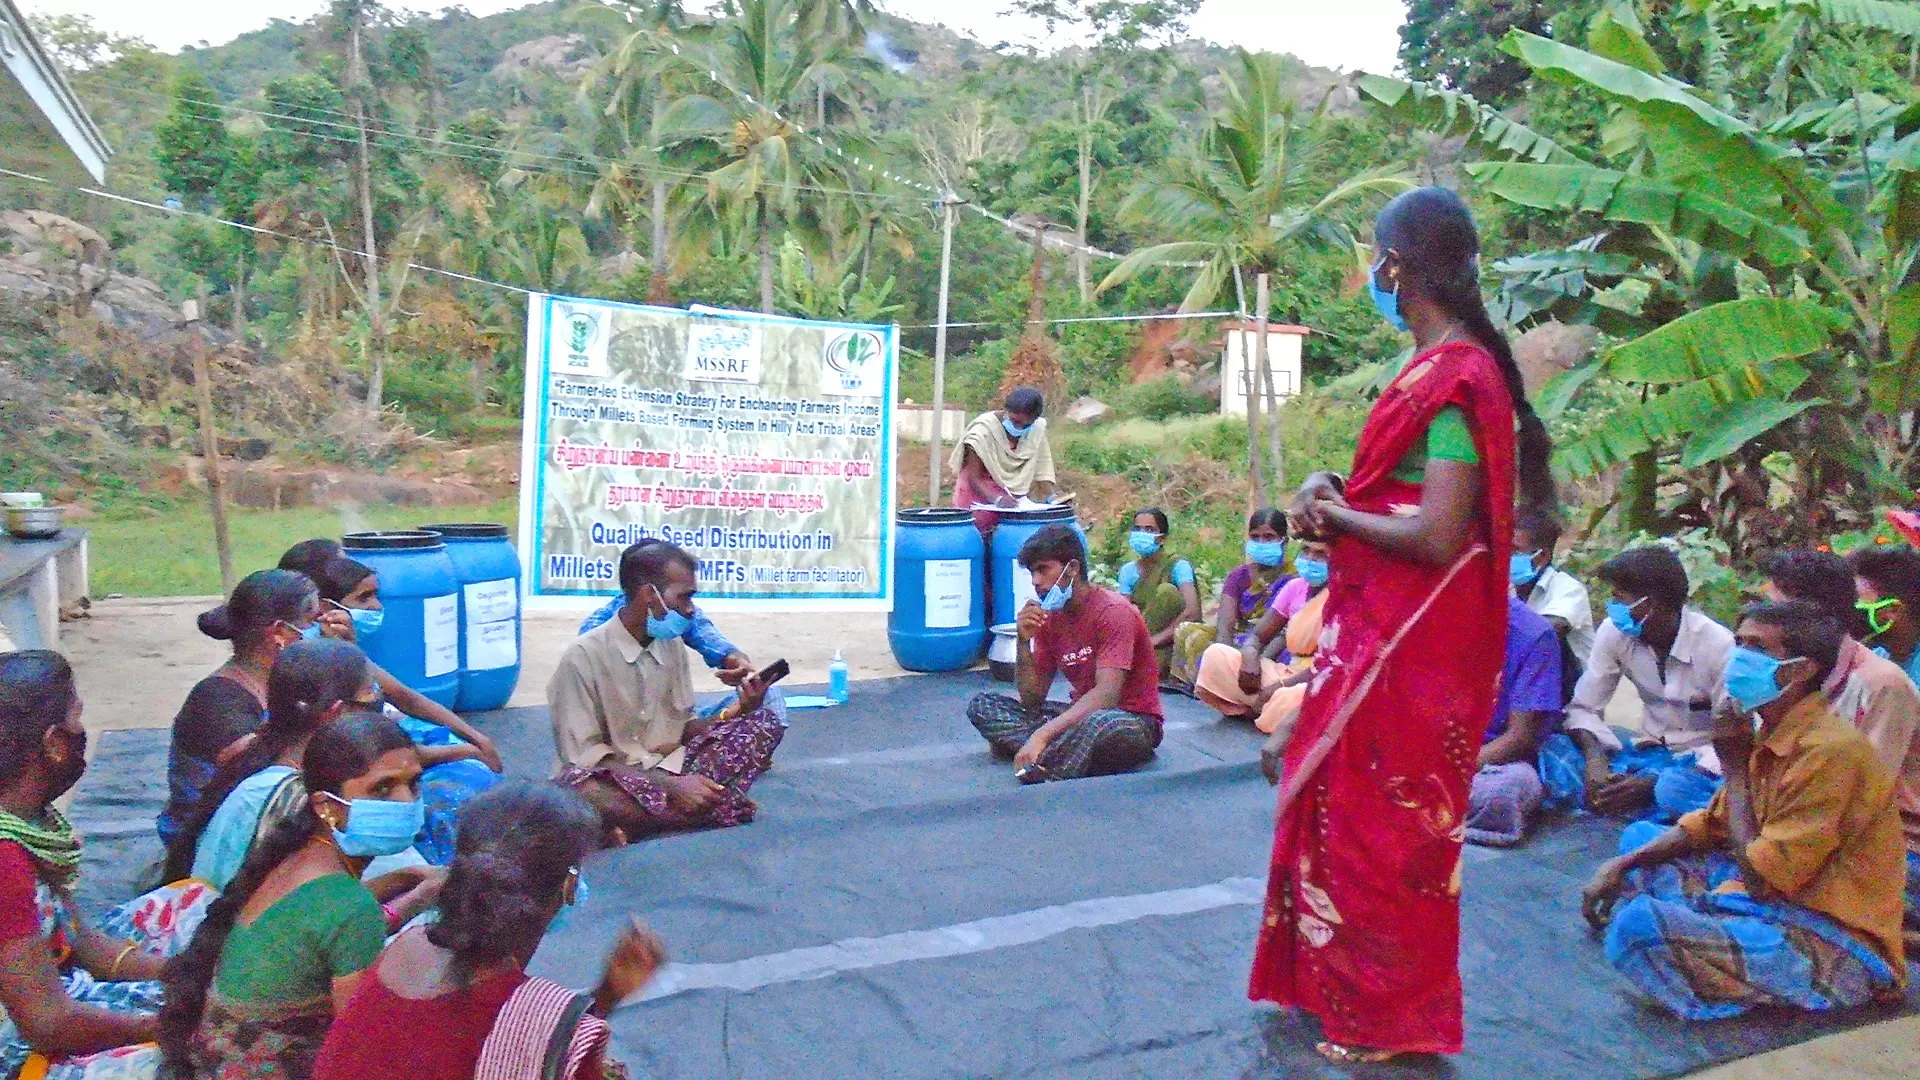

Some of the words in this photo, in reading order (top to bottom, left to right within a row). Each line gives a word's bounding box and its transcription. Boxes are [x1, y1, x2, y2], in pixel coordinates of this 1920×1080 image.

[695, 356, 749, 373] MSSRF
[621, 387, 673, 405] Extension
[720, 395, 736, 408] For
[739, 396, 798, 415] Enchancing
[800, 399, 840, 415] Farmers
[843, 402, 879, 416] Income
[552, 402, 595, 422] Through
[599, 406, 636, 422] Millets
[639, 410, 669, 426] Based
[672, 414, 713, 432] Farming
[717, 417, 754, 434] System
[757, 419, 767, 432] In
[771, 420, 792, 436] Hilly
[796, 421, 814, 434] And
[817, 422, 846, 436] Tribal
[662, 525, 704, 547] Seed
[711, 528, 812, 550] Distribution
[817, 530, 831, 550] in
[550, 556, 613, 579] Millets
[700, 560, 745, 582] MFFs
[787, 567, 810, 582] farm
[812, 567, 865, 586] facilitator)
